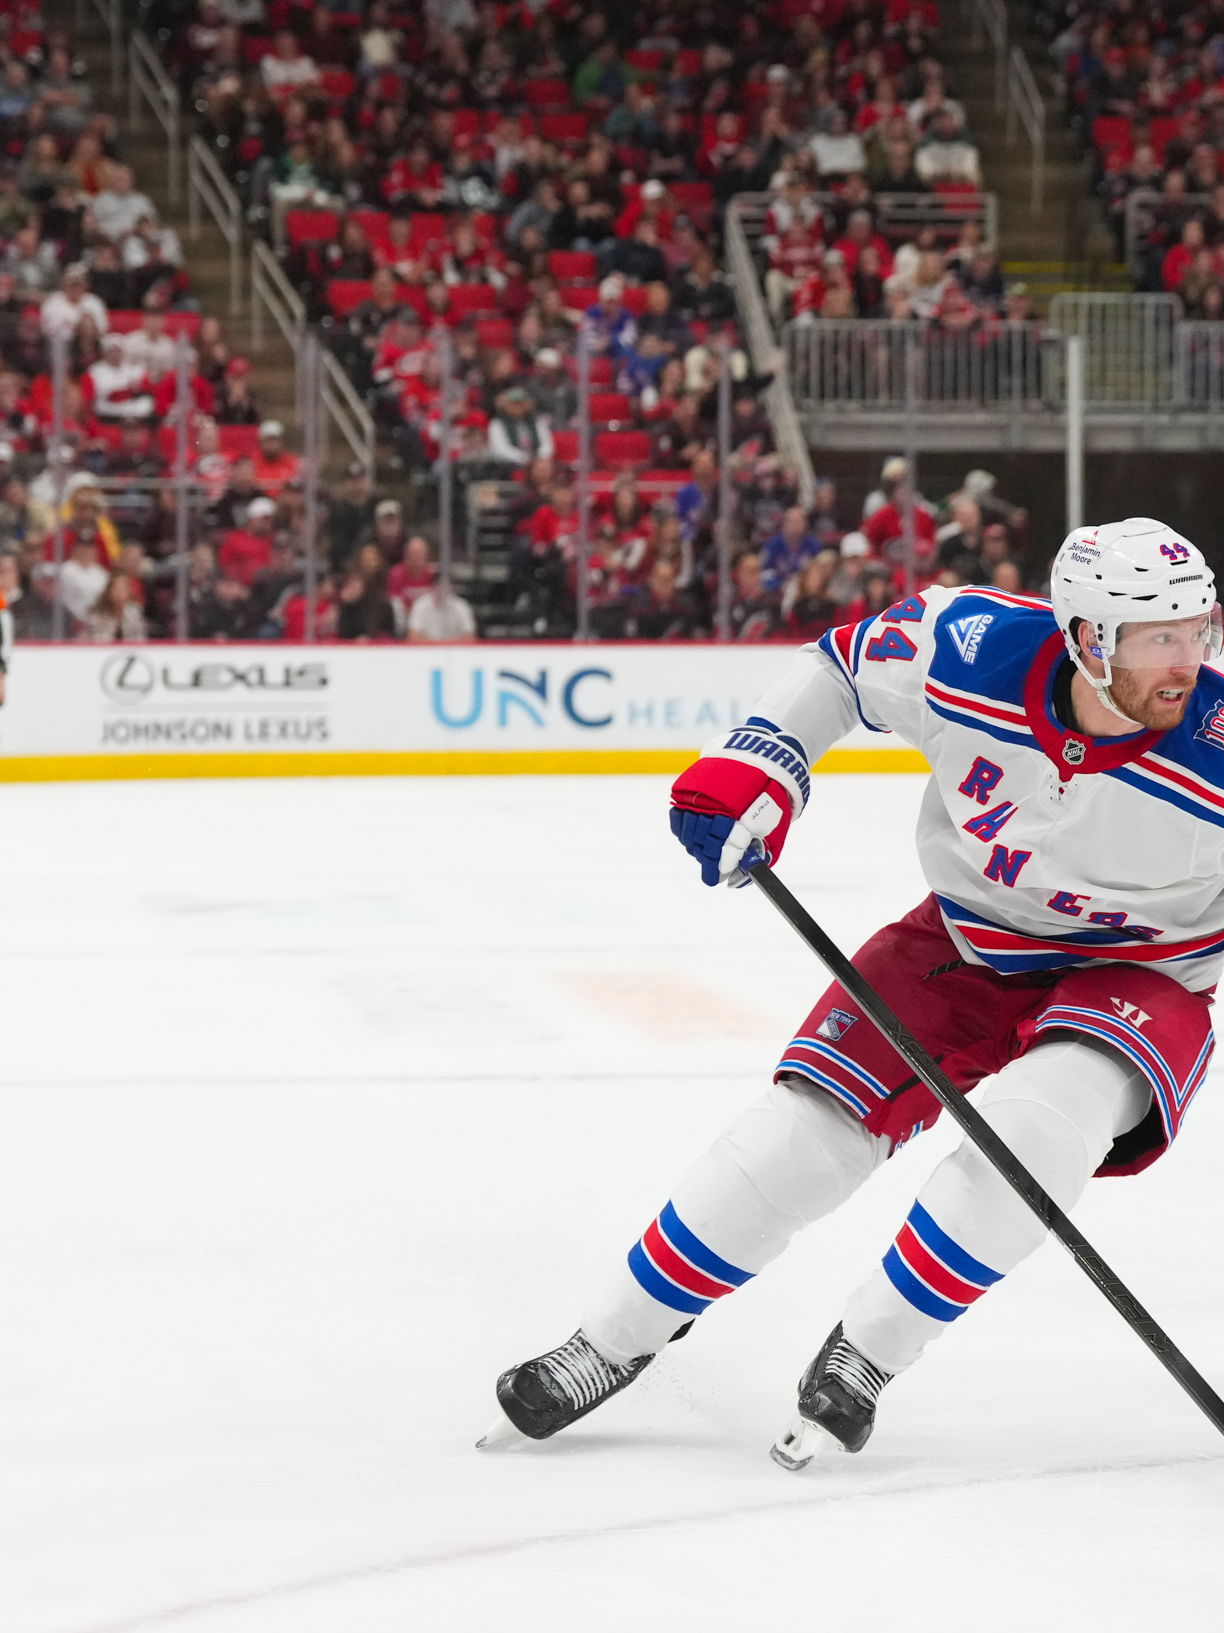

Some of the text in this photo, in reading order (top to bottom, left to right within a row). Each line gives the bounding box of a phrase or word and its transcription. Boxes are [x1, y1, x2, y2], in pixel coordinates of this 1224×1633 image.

[1070, 552, 1092, 565] Moore
[1072, 542, 1101, 557] Benjamin
[1160, 543, 1191, 561] 44
[865, 593, 928, 662] 44
[964, 614, 994, 663] GAME
[162, 662, 328, 691] LEXUS
[430, 667, 613, 728] UNC
[102, 716, 329, 746] JOHNSON LEXUS
[723, 732, 811, 818] WARRIO
[957, 755, 1165, 941] RANERS
